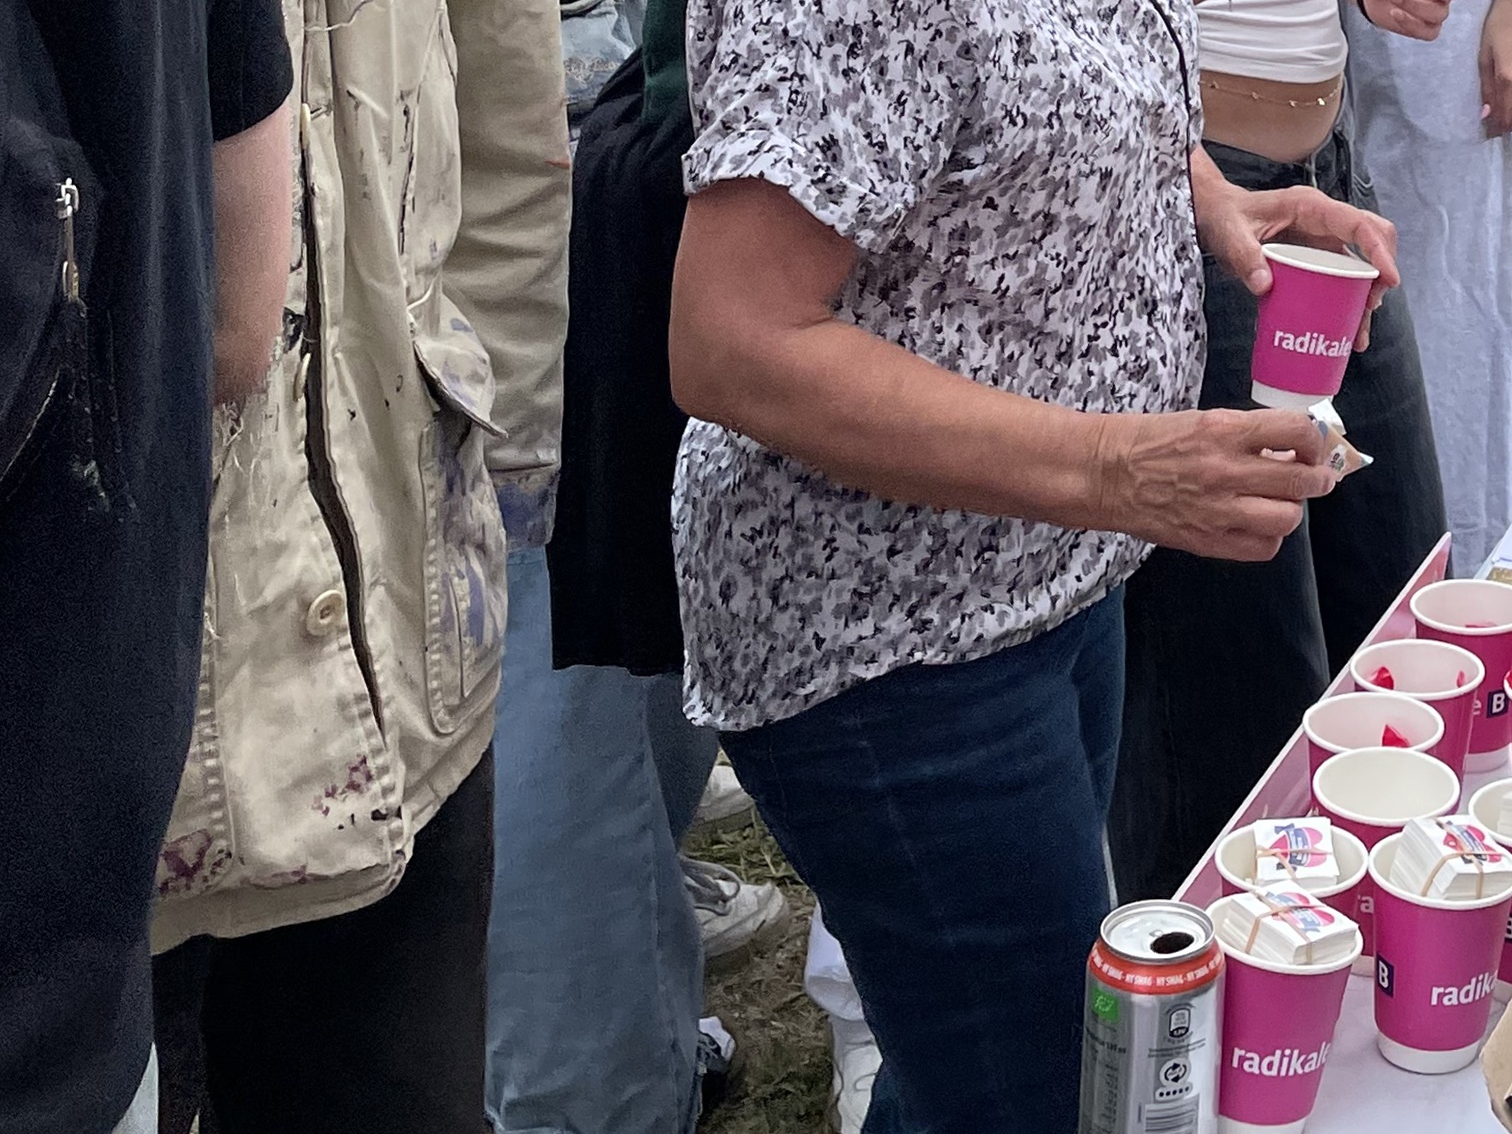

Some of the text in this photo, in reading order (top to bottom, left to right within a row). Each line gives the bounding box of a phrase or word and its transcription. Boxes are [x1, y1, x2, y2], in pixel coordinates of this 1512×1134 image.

[1274, 329, 1352, 357] radikale
[1492, 693, 1506, 713] B
[1378, 959, 1389, 989] B
